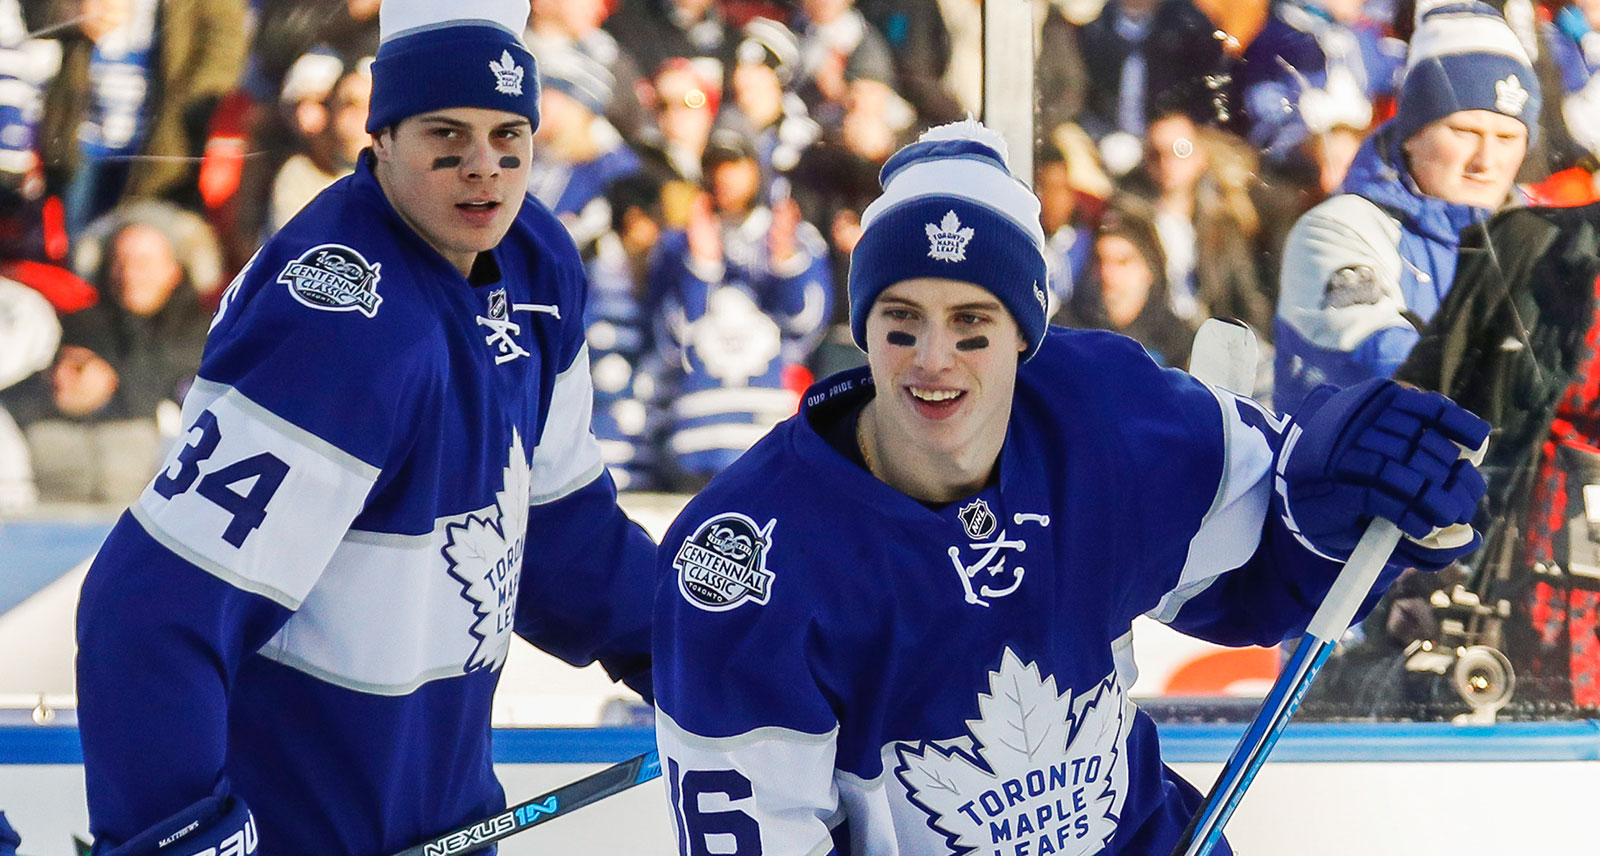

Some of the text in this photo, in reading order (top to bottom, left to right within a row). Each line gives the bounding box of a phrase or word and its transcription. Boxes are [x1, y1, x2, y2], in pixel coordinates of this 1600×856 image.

[933, 232, 965, 243] TORONTO
[290, 265, 374, 307] CENTENNIAL
[301, 279, 350, 303] CLASSIC
[153, 408, 291, 550] 34
[971, 509, 986, 534] NHL
[683, 545, 763, 592] CENTENNIAL
[689, 566, 737, 596] CLASSIC
[688, 581, 724, 602] TORONTO
[667, 756, 763, 856] 16
[957, 755, 1102, 827] TORONTO
[158, 820, 199, 848] MATTHEWS
[989, 786, 1087, 844] MAPLE
[994, 814, 1089, 856] EAFS
